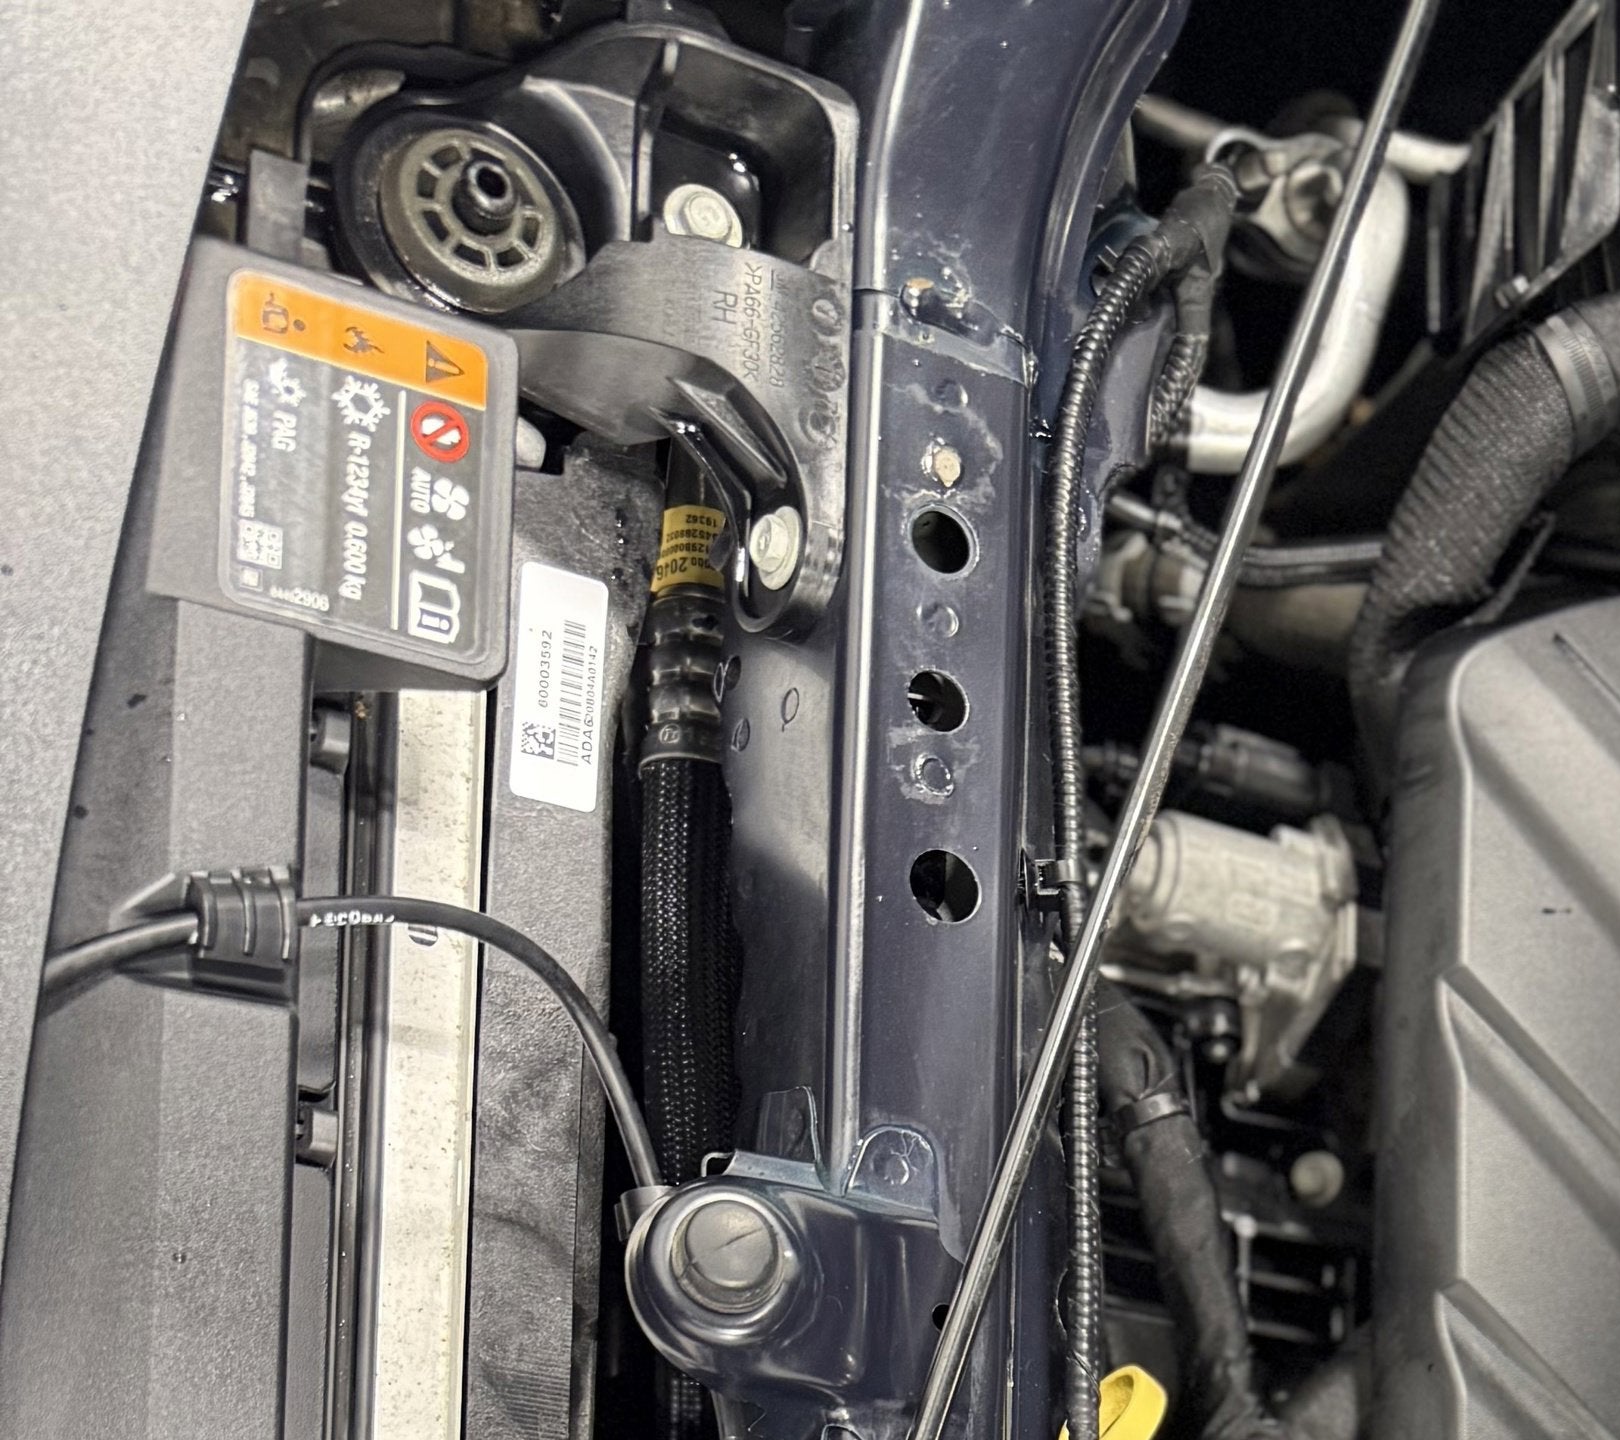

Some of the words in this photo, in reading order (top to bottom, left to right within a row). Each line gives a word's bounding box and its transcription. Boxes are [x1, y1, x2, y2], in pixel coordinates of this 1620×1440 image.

[712, 290, 739, 325] RH
[270, 410, 297, 452] PAG
[410, 468, 432, 513] AUTO
[344, 521, 367, 574] 0.600
[338, 574, 365, 600] kg
